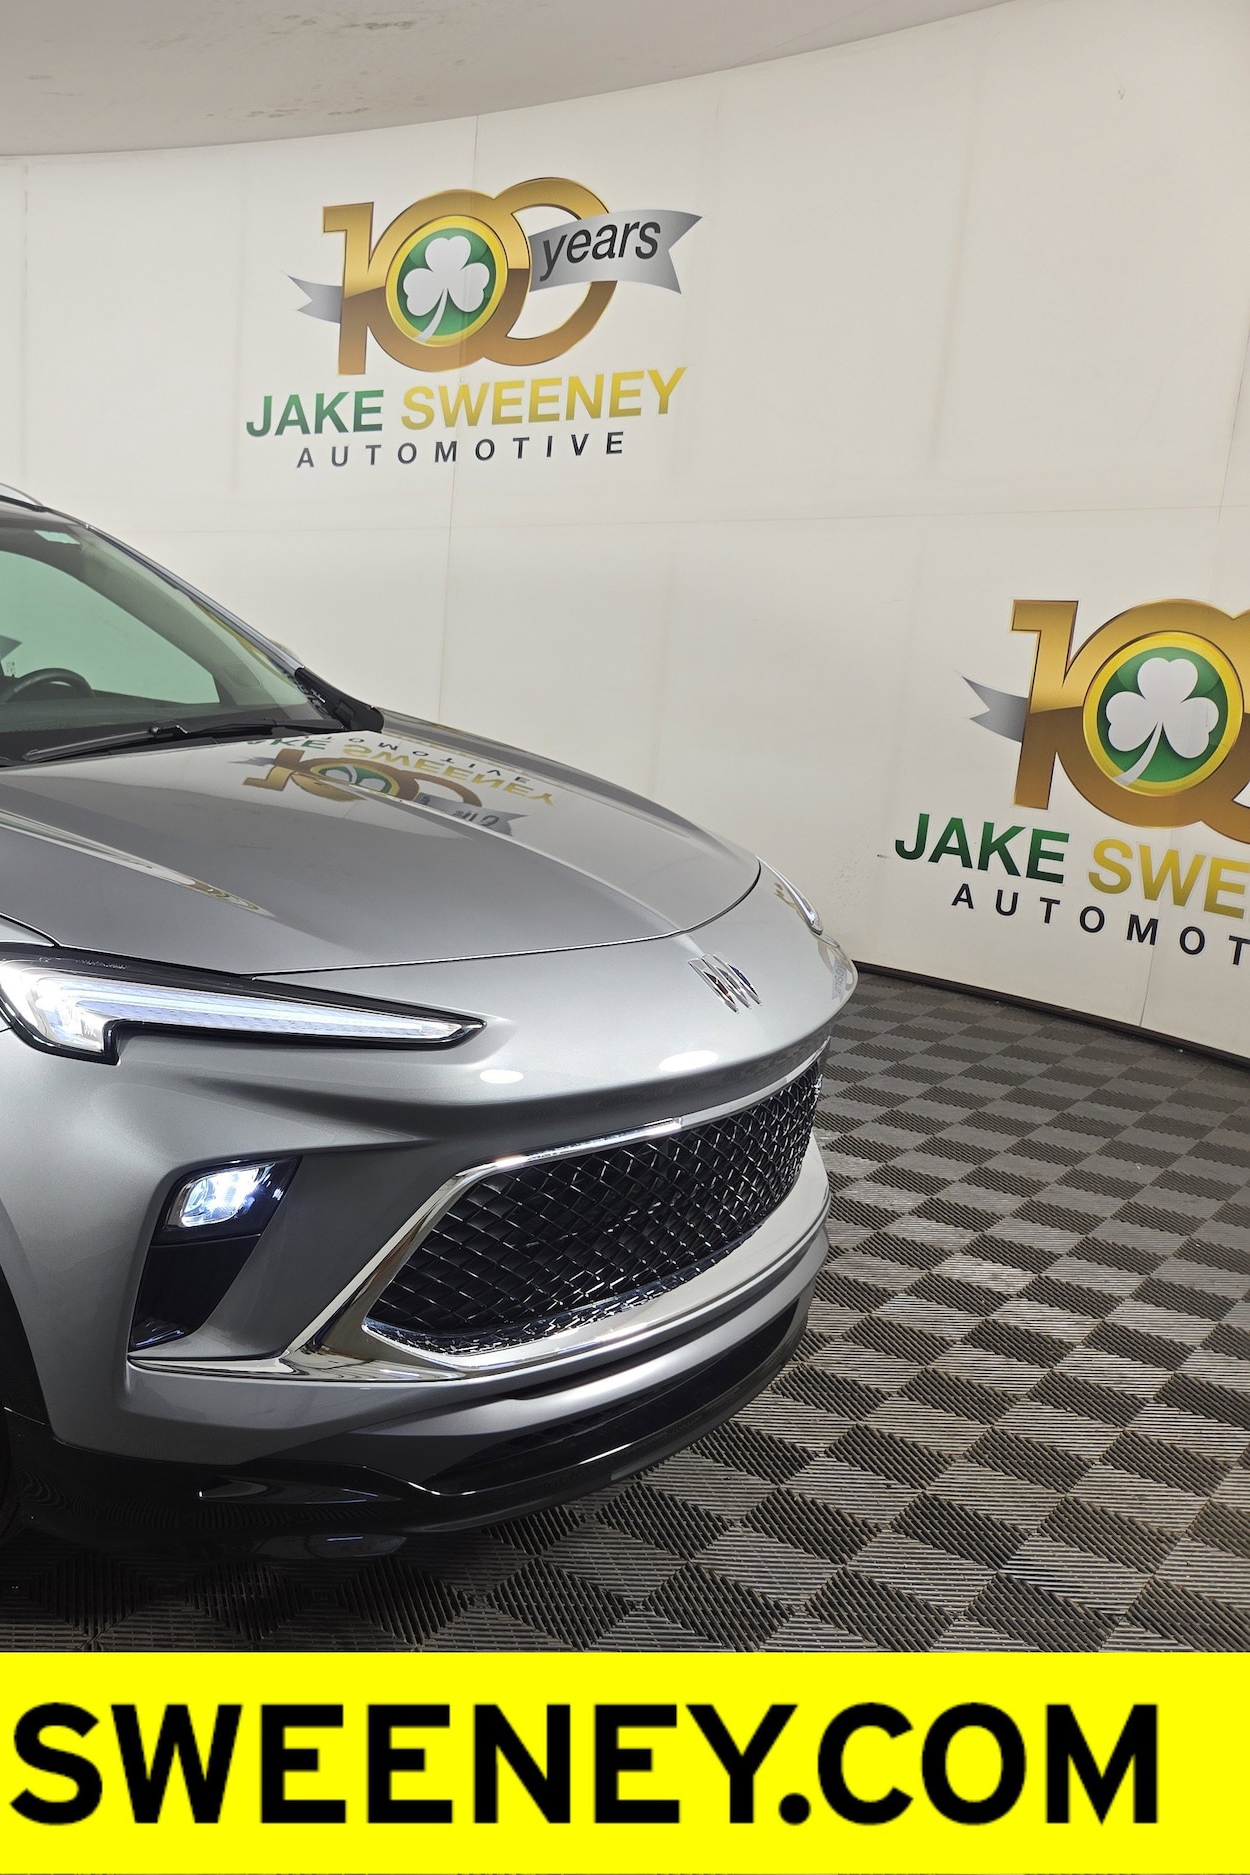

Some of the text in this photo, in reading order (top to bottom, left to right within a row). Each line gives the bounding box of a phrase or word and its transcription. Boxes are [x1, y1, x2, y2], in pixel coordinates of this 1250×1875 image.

[538, 221, 661, 282] years
[246, 366, 688, 438] JAKE SWEENEY
[296, 431, 625, 469] AUTOMOTIVE
[895, 813, 1070, 885] JAKE
